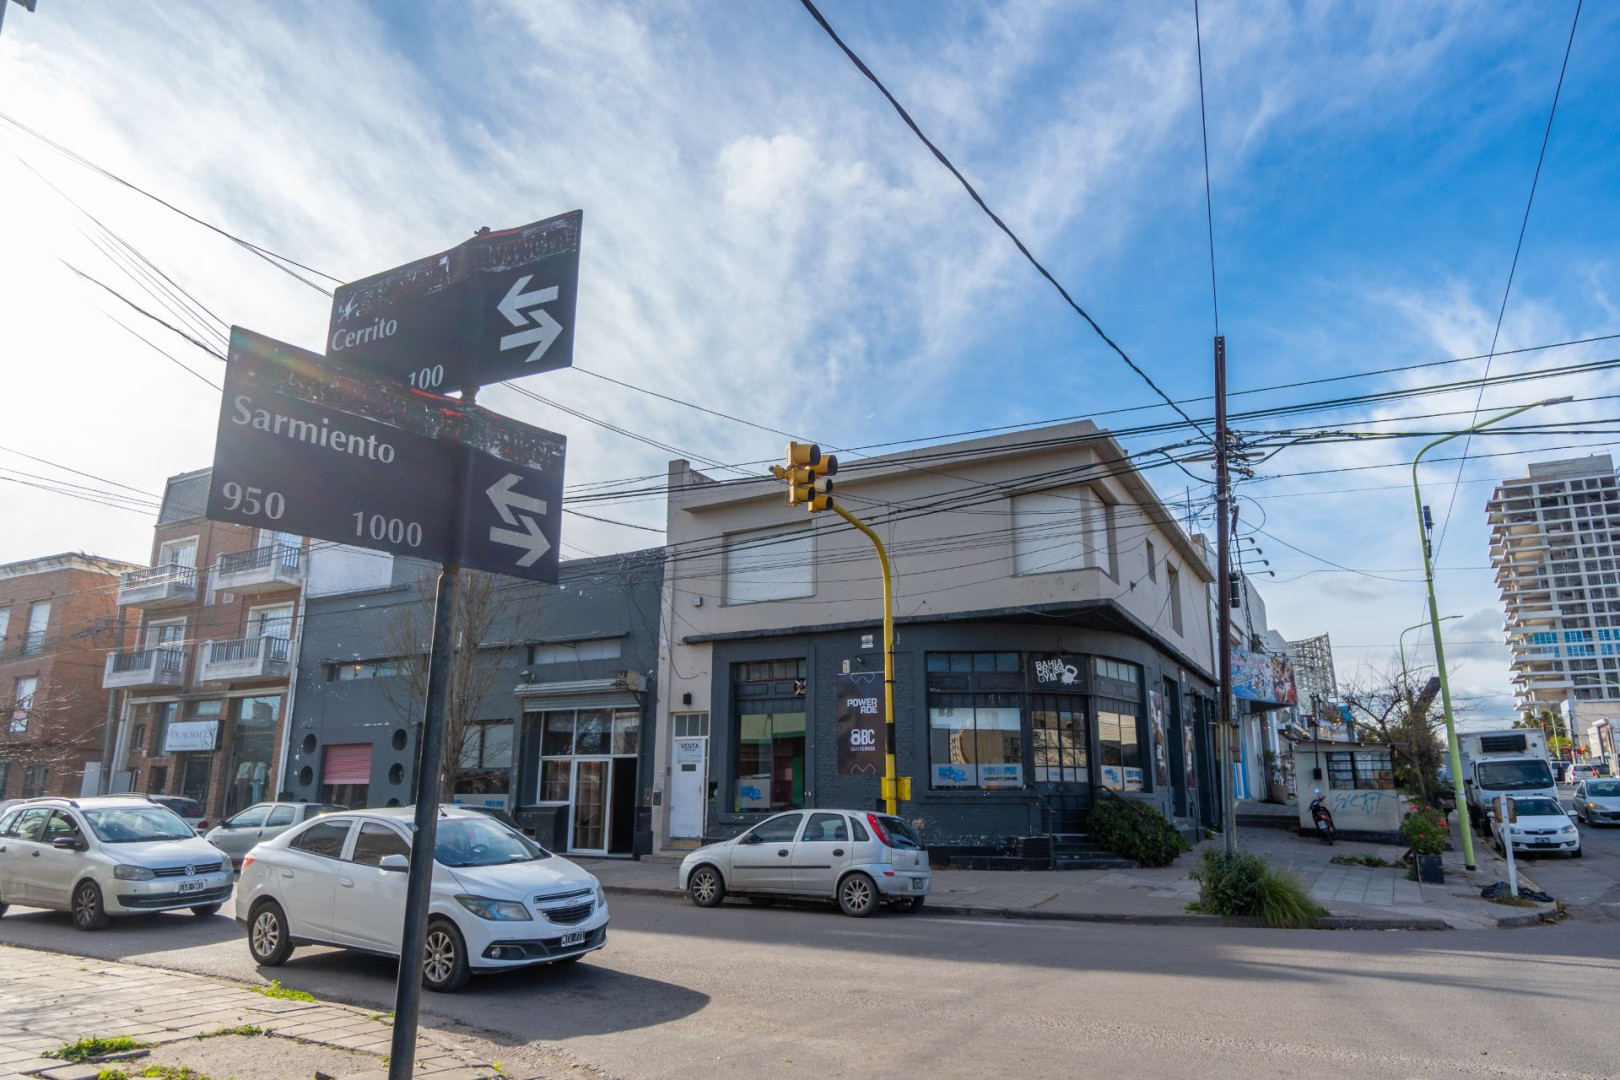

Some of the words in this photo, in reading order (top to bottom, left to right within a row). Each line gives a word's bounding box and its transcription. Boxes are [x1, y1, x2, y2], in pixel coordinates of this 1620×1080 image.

[331, 317, 398, 351] Cerrito
[408, 364, 444, 389] 100
[232, 395, 395, 464] Sarmiento
[222, 482, 286, 520] 950
[352, 510, 423, 548] 1000
[1035, 659, 1064, 669] BAHIA
[1037, 666, 1065, 675] CROSS
[1038, 672, 1058, 683] GYM
[847, 697, 878, 708] POWER
